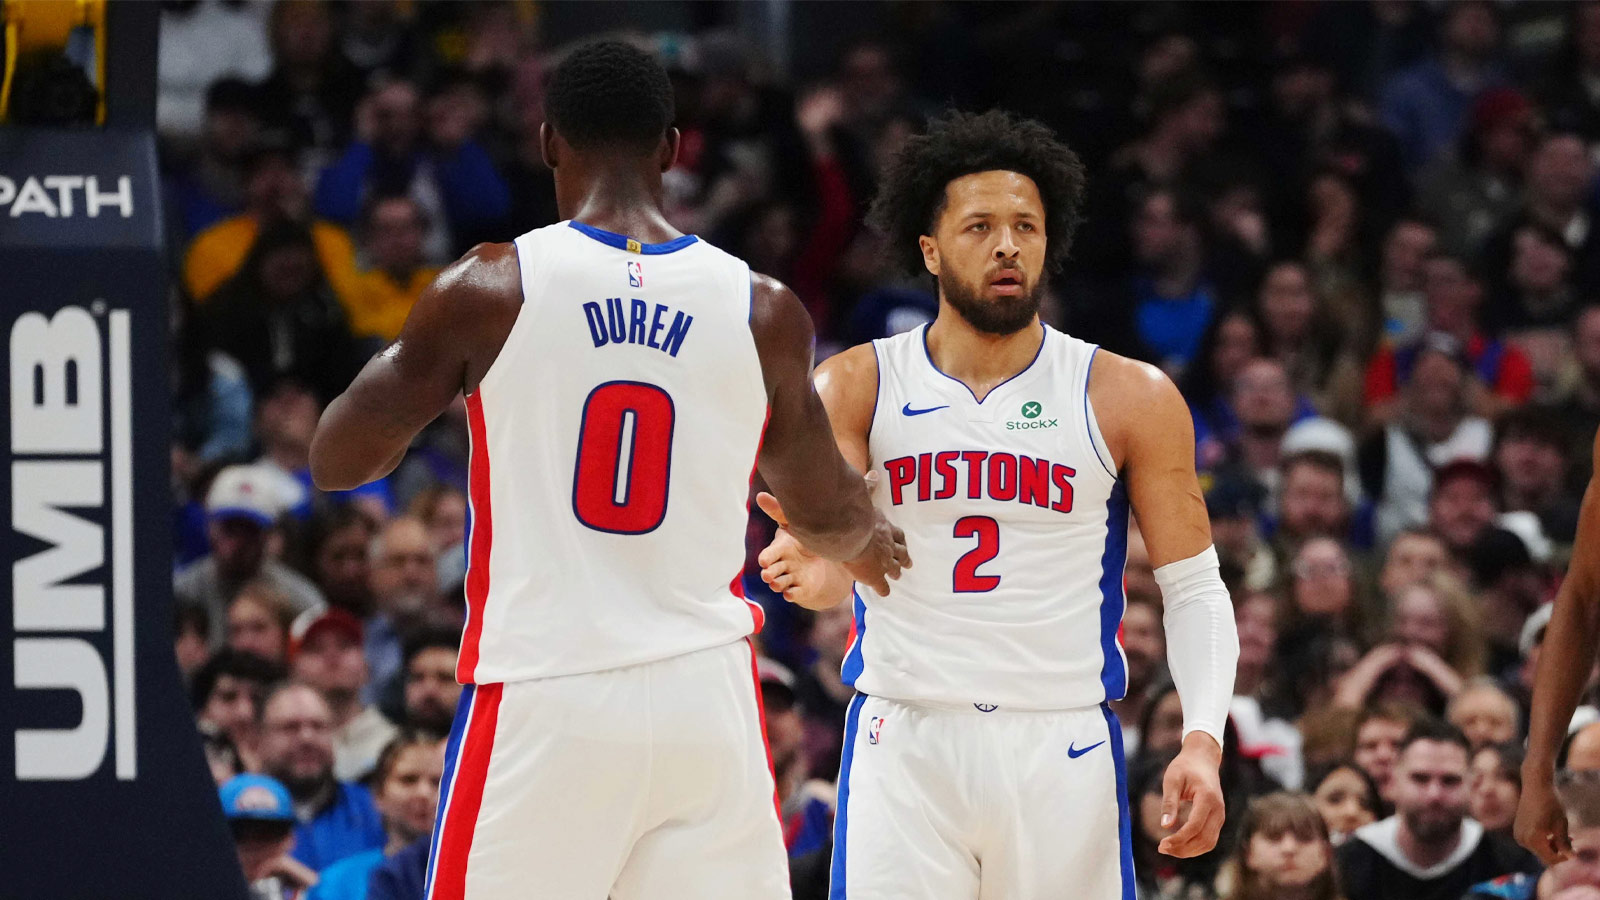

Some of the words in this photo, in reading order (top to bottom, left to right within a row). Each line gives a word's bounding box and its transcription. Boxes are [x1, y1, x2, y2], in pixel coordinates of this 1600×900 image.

[582, 297, 694, 358] DUREN
[572, 380, 676, 535] 0
[1006, 418, 1058, 430] StockX
[884, 450, 1077, 514] PISTONS
[9, 305, 110, 781] UMB
[952, 515, 1002, 593] 2
